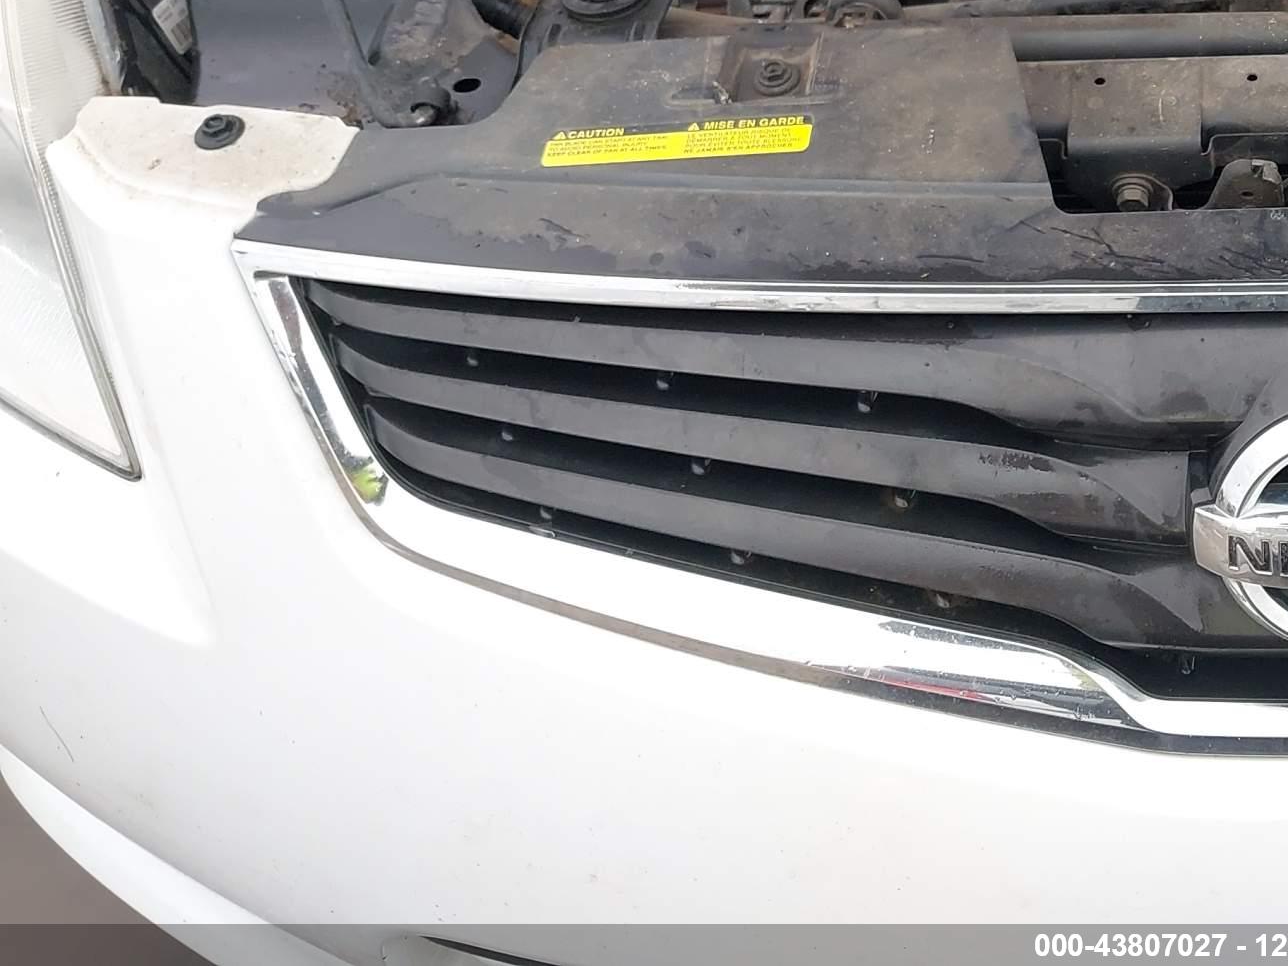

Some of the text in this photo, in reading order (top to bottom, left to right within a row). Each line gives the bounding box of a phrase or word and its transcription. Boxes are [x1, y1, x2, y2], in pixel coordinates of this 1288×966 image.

[703, 116, 805, 130] MISE EN GARDE
[567, 128, 625, 139] CAUTION
